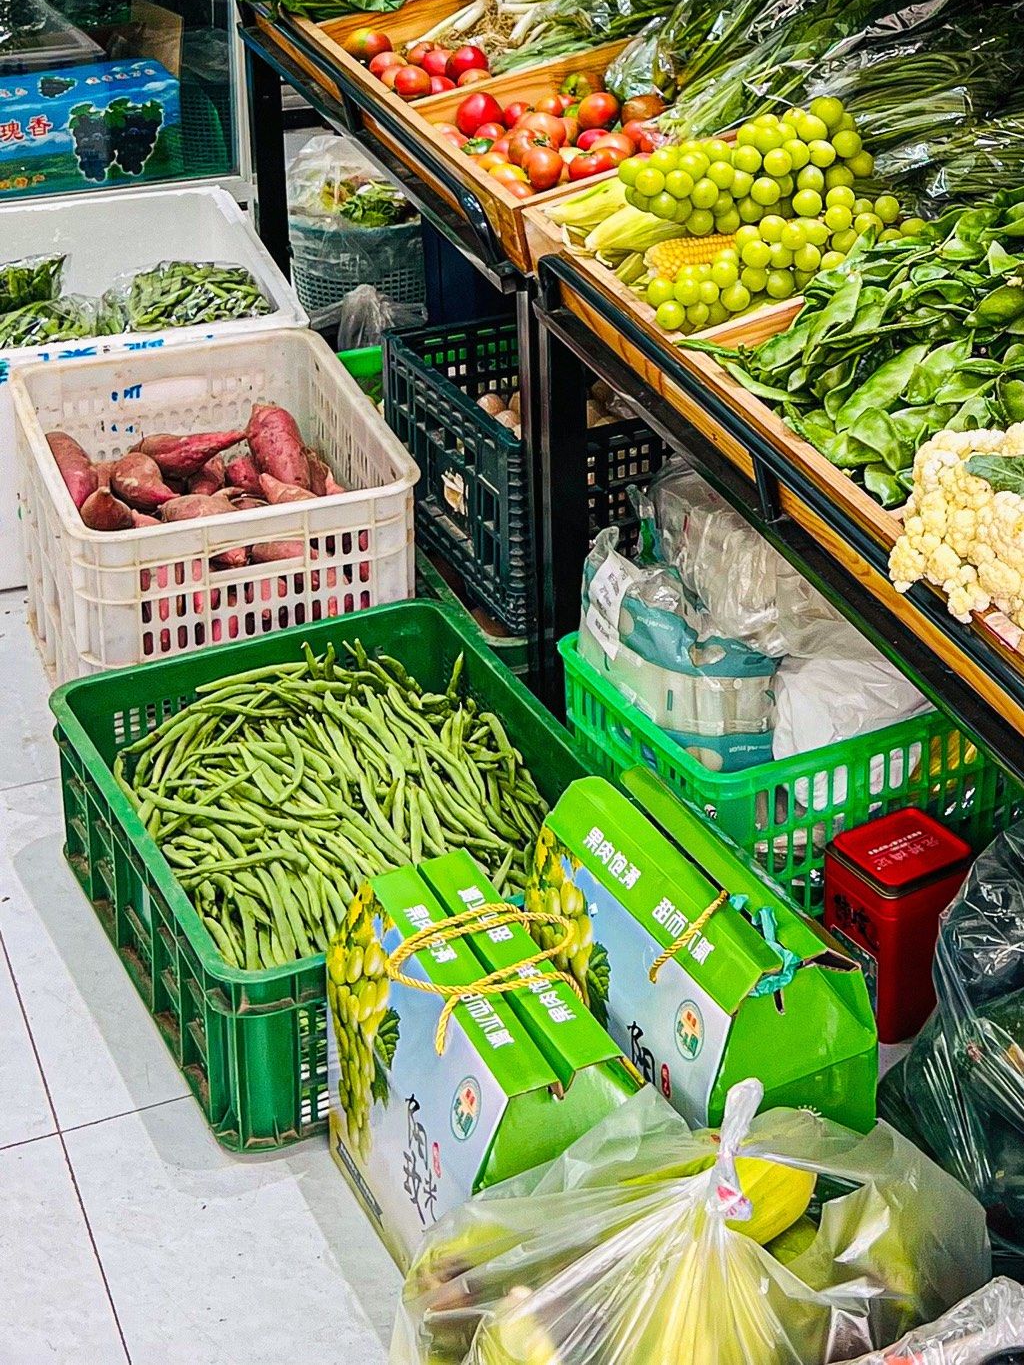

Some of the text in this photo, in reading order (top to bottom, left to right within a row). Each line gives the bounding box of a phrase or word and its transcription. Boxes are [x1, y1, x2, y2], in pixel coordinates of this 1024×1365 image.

[0, 115, 52, 141] 瑰香
[582, 826, 641, 890] 果肉饱满
